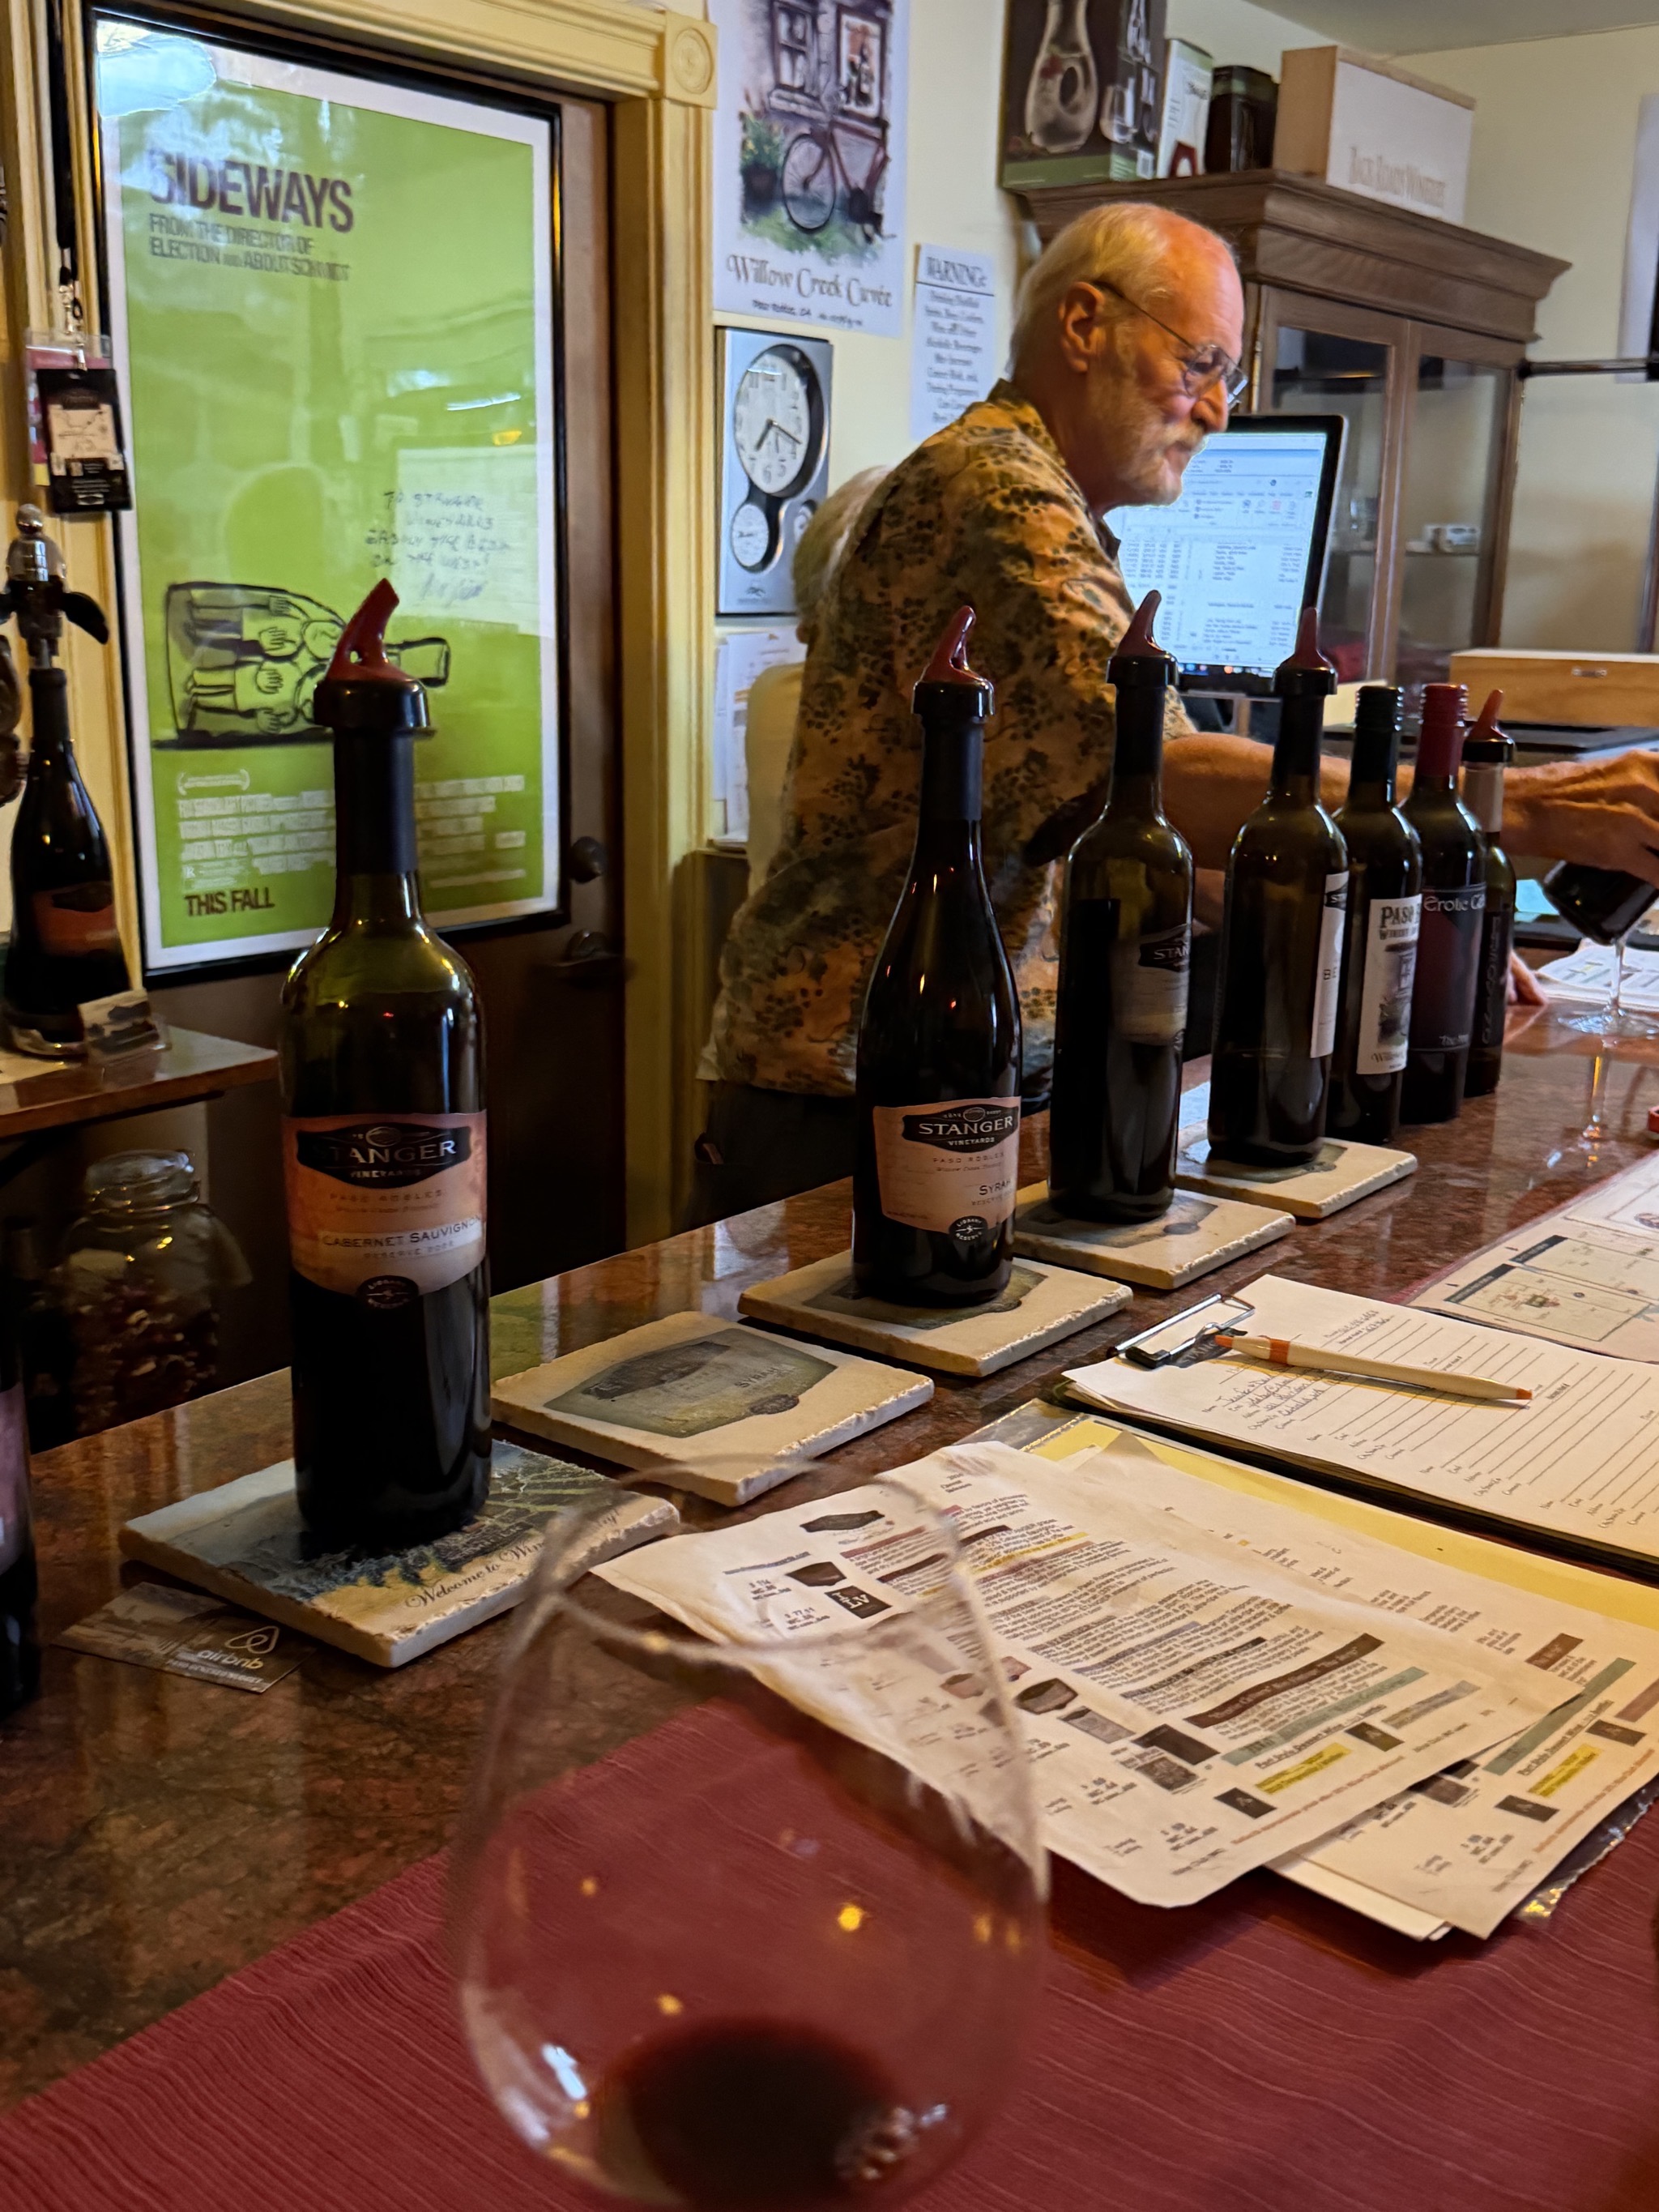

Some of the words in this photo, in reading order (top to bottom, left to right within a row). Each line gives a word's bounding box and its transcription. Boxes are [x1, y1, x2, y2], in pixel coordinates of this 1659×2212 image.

[147, 149, 354, 233] SIDEWAYS
[149, 237, 221, 265] ELECTION
[727, 254, 794, 288] Willow
[796, 268, 843, 299] Creek
[184, 891, 228, 917] THIS
[231, 886, 275, 913] FALL
[919, 1115, 1013, 1136] STANGER
[313, 1139, 457, 1165] TANGER
[947, 1137, 996, 1147] VINEYARDS
[324, 1234, 406, 1249] CABERNET
[405, 1570, 485, 1608] Welcome
[485, 1562, 501, 1576] to
[498, 1539, 549, 1563] Win
[195, 1649, 265, 1670] airbnb
